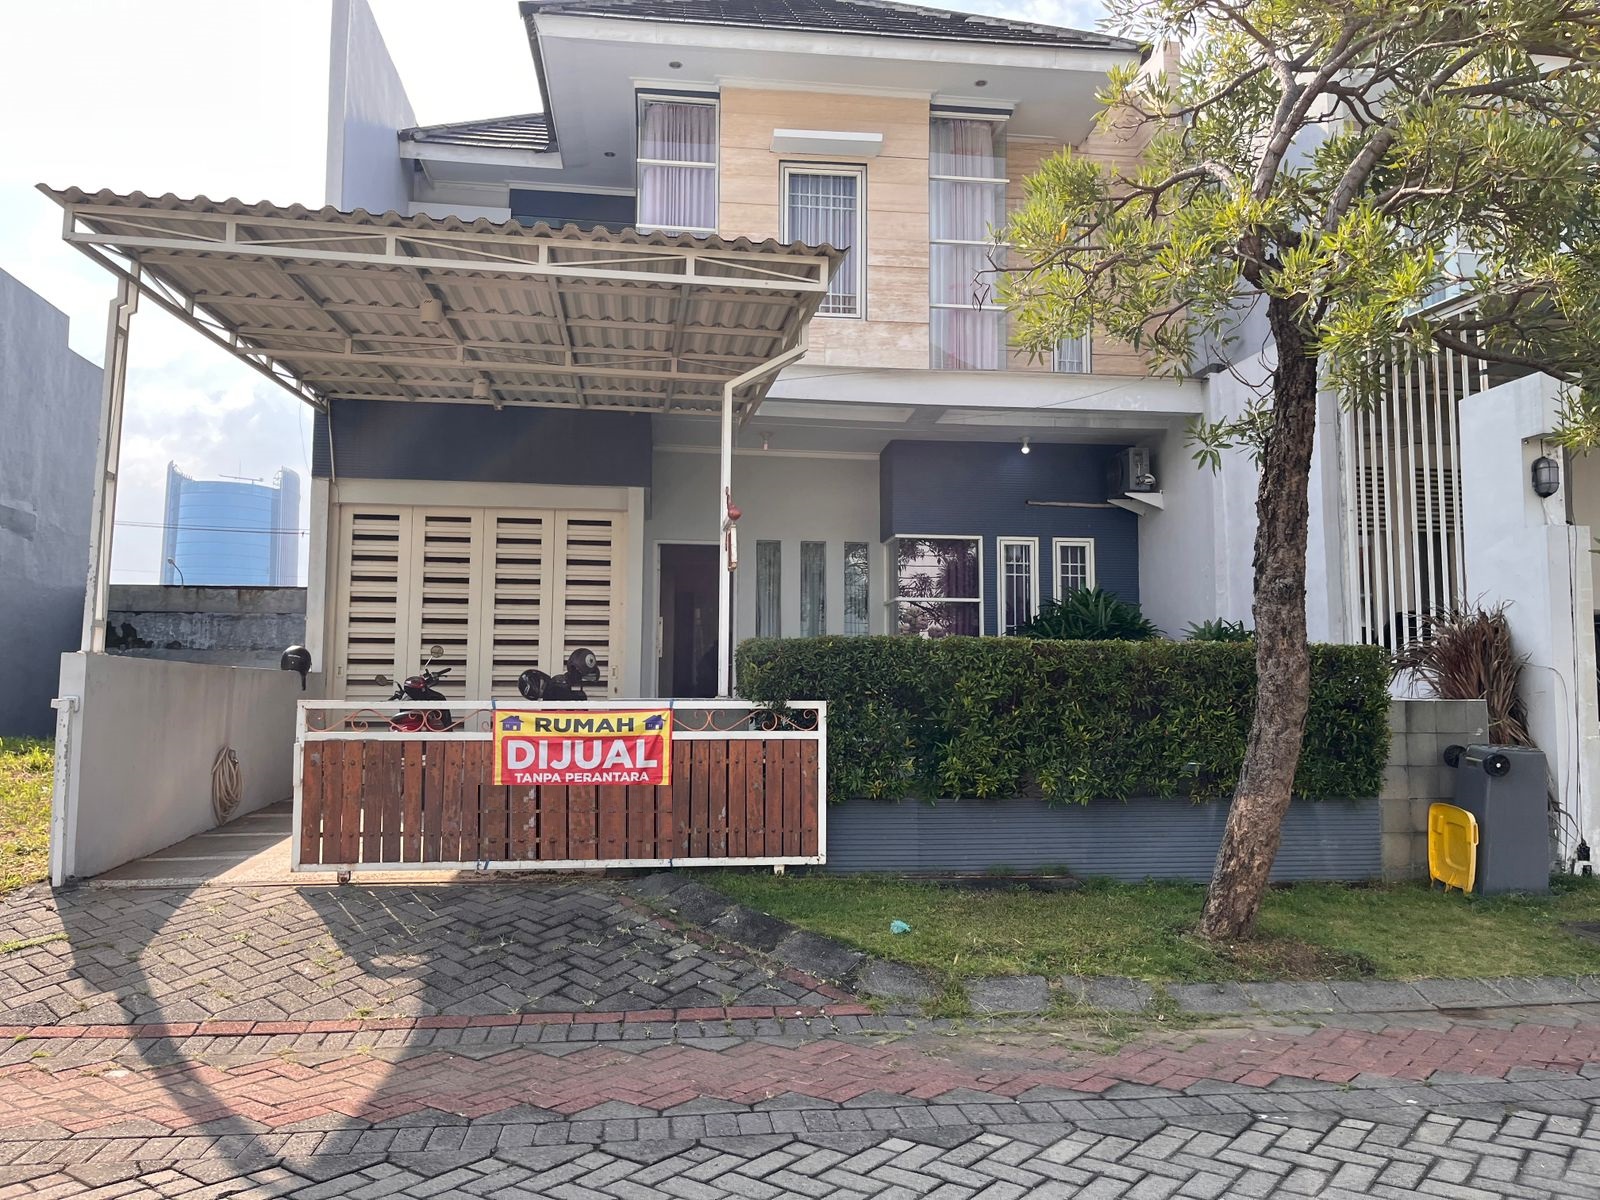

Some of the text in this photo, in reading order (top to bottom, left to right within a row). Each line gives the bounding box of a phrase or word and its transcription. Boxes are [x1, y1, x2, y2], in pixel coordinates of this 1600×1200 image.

[535, 717, 635, 733] RUMAH
[507, 739, 658, 770] DIJUAL
[515, 771, 649, 783] TANPA PERANTARA
